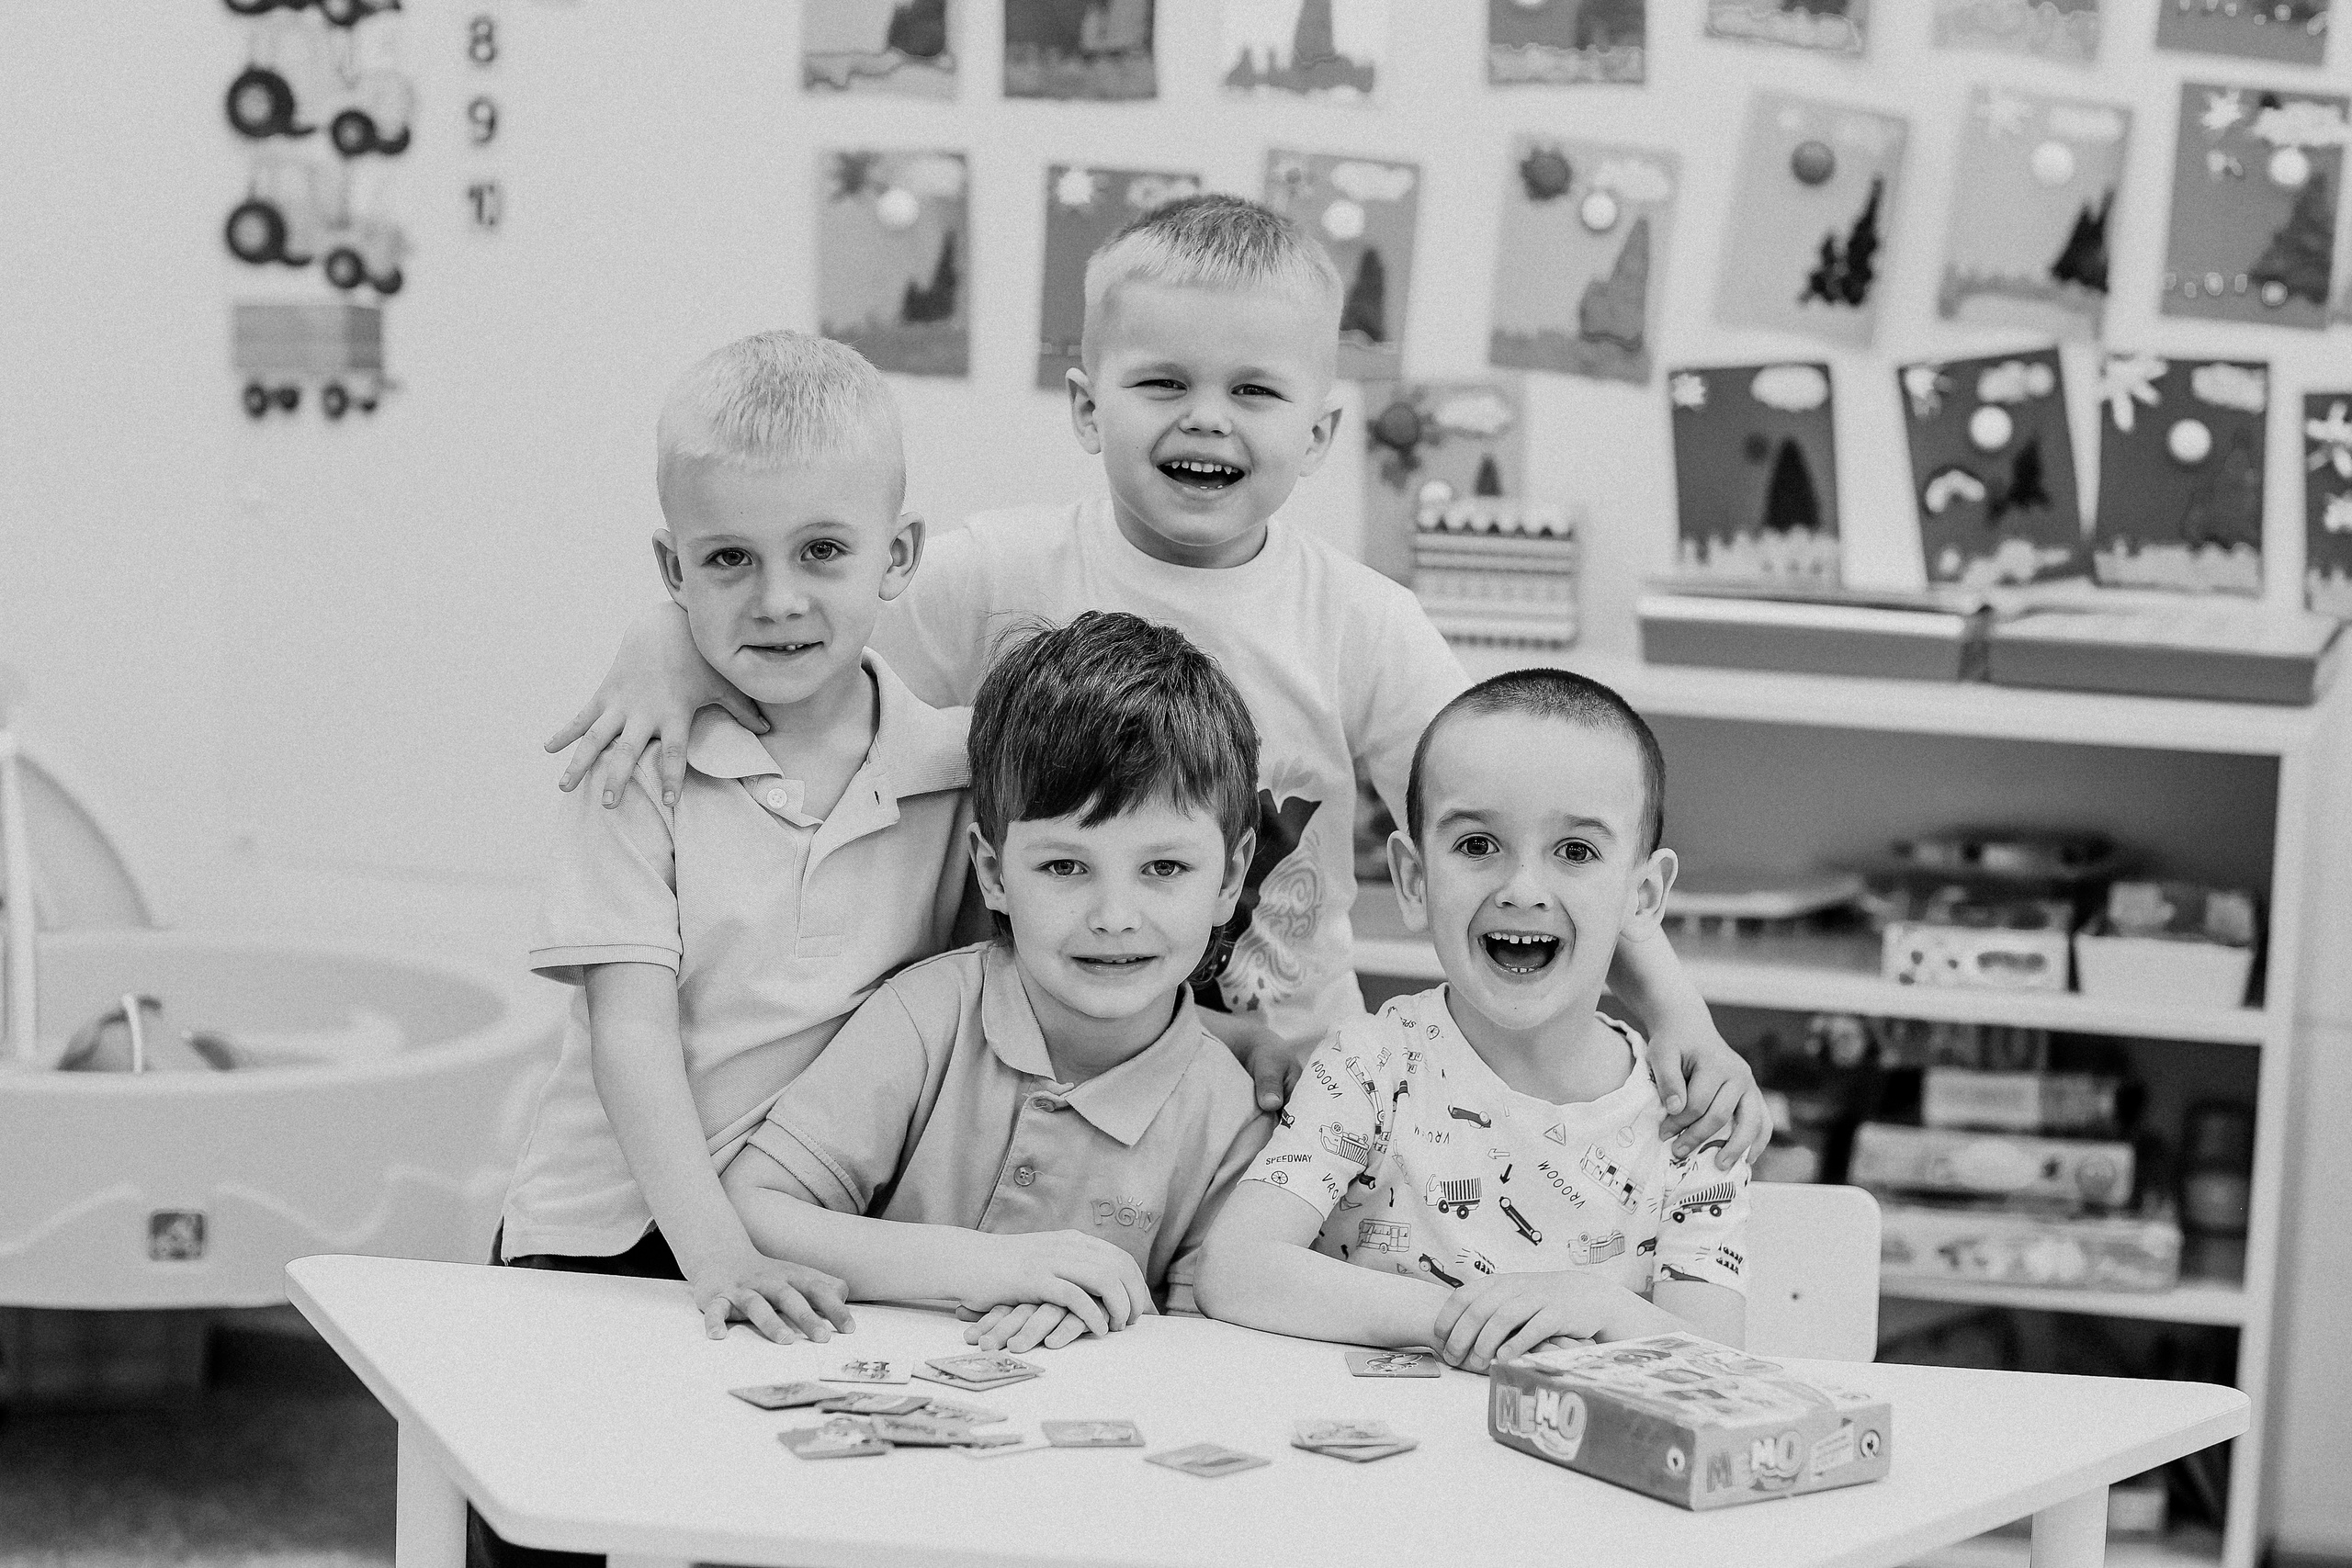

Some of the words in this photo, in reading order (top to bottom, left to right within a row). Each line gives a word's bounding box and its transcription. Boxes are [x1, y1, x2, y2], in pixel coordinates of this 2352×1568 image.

[467, 16, 496, 65] 8
[467, 97, 497, 147] 9
[1265, 1154, 1313, 1166] SPEEDWAY
[1537, 1159, 1586, 1209] VROOOM
